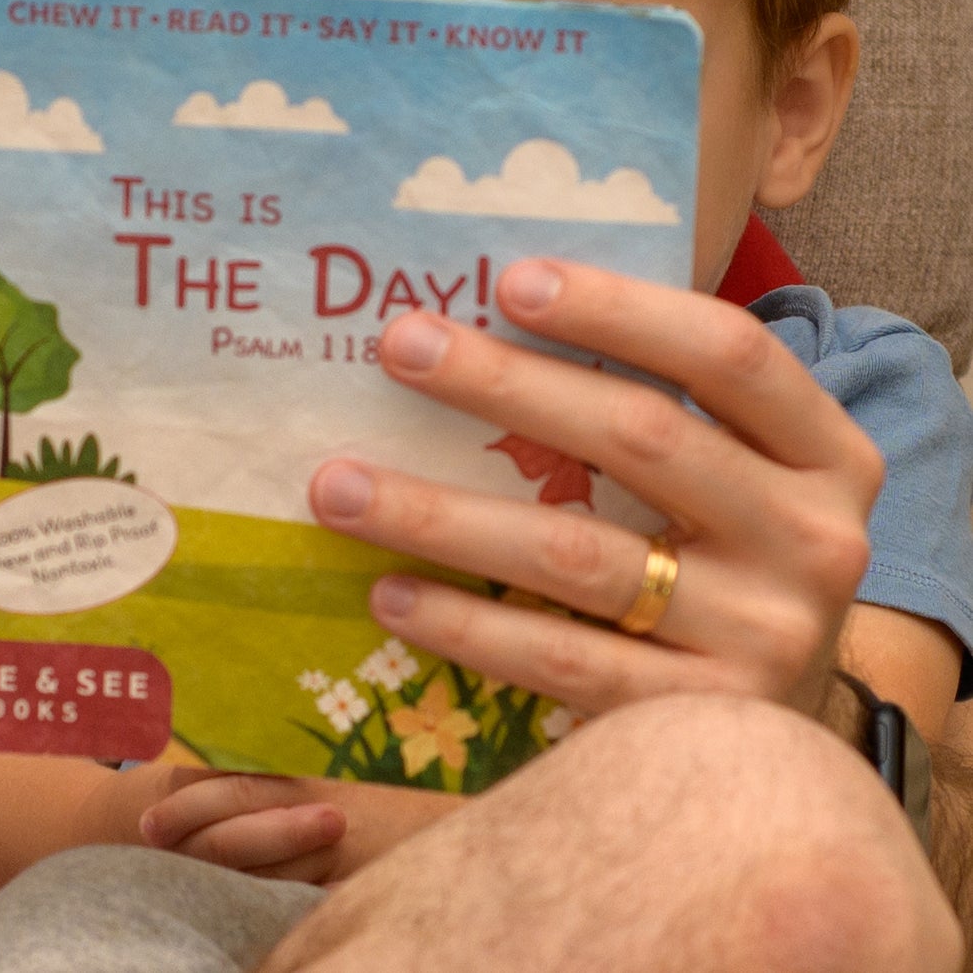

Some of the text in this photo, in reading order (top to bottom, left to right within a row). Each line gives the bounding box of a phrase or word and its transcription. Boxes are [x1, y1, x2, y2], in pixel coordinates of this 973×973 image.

[8, 0, 589, 54] CHEW IT READ IT SAY IT KNOW IT
[35, 666, 59, 694] &
[77, 669, 149, 700] SEE
